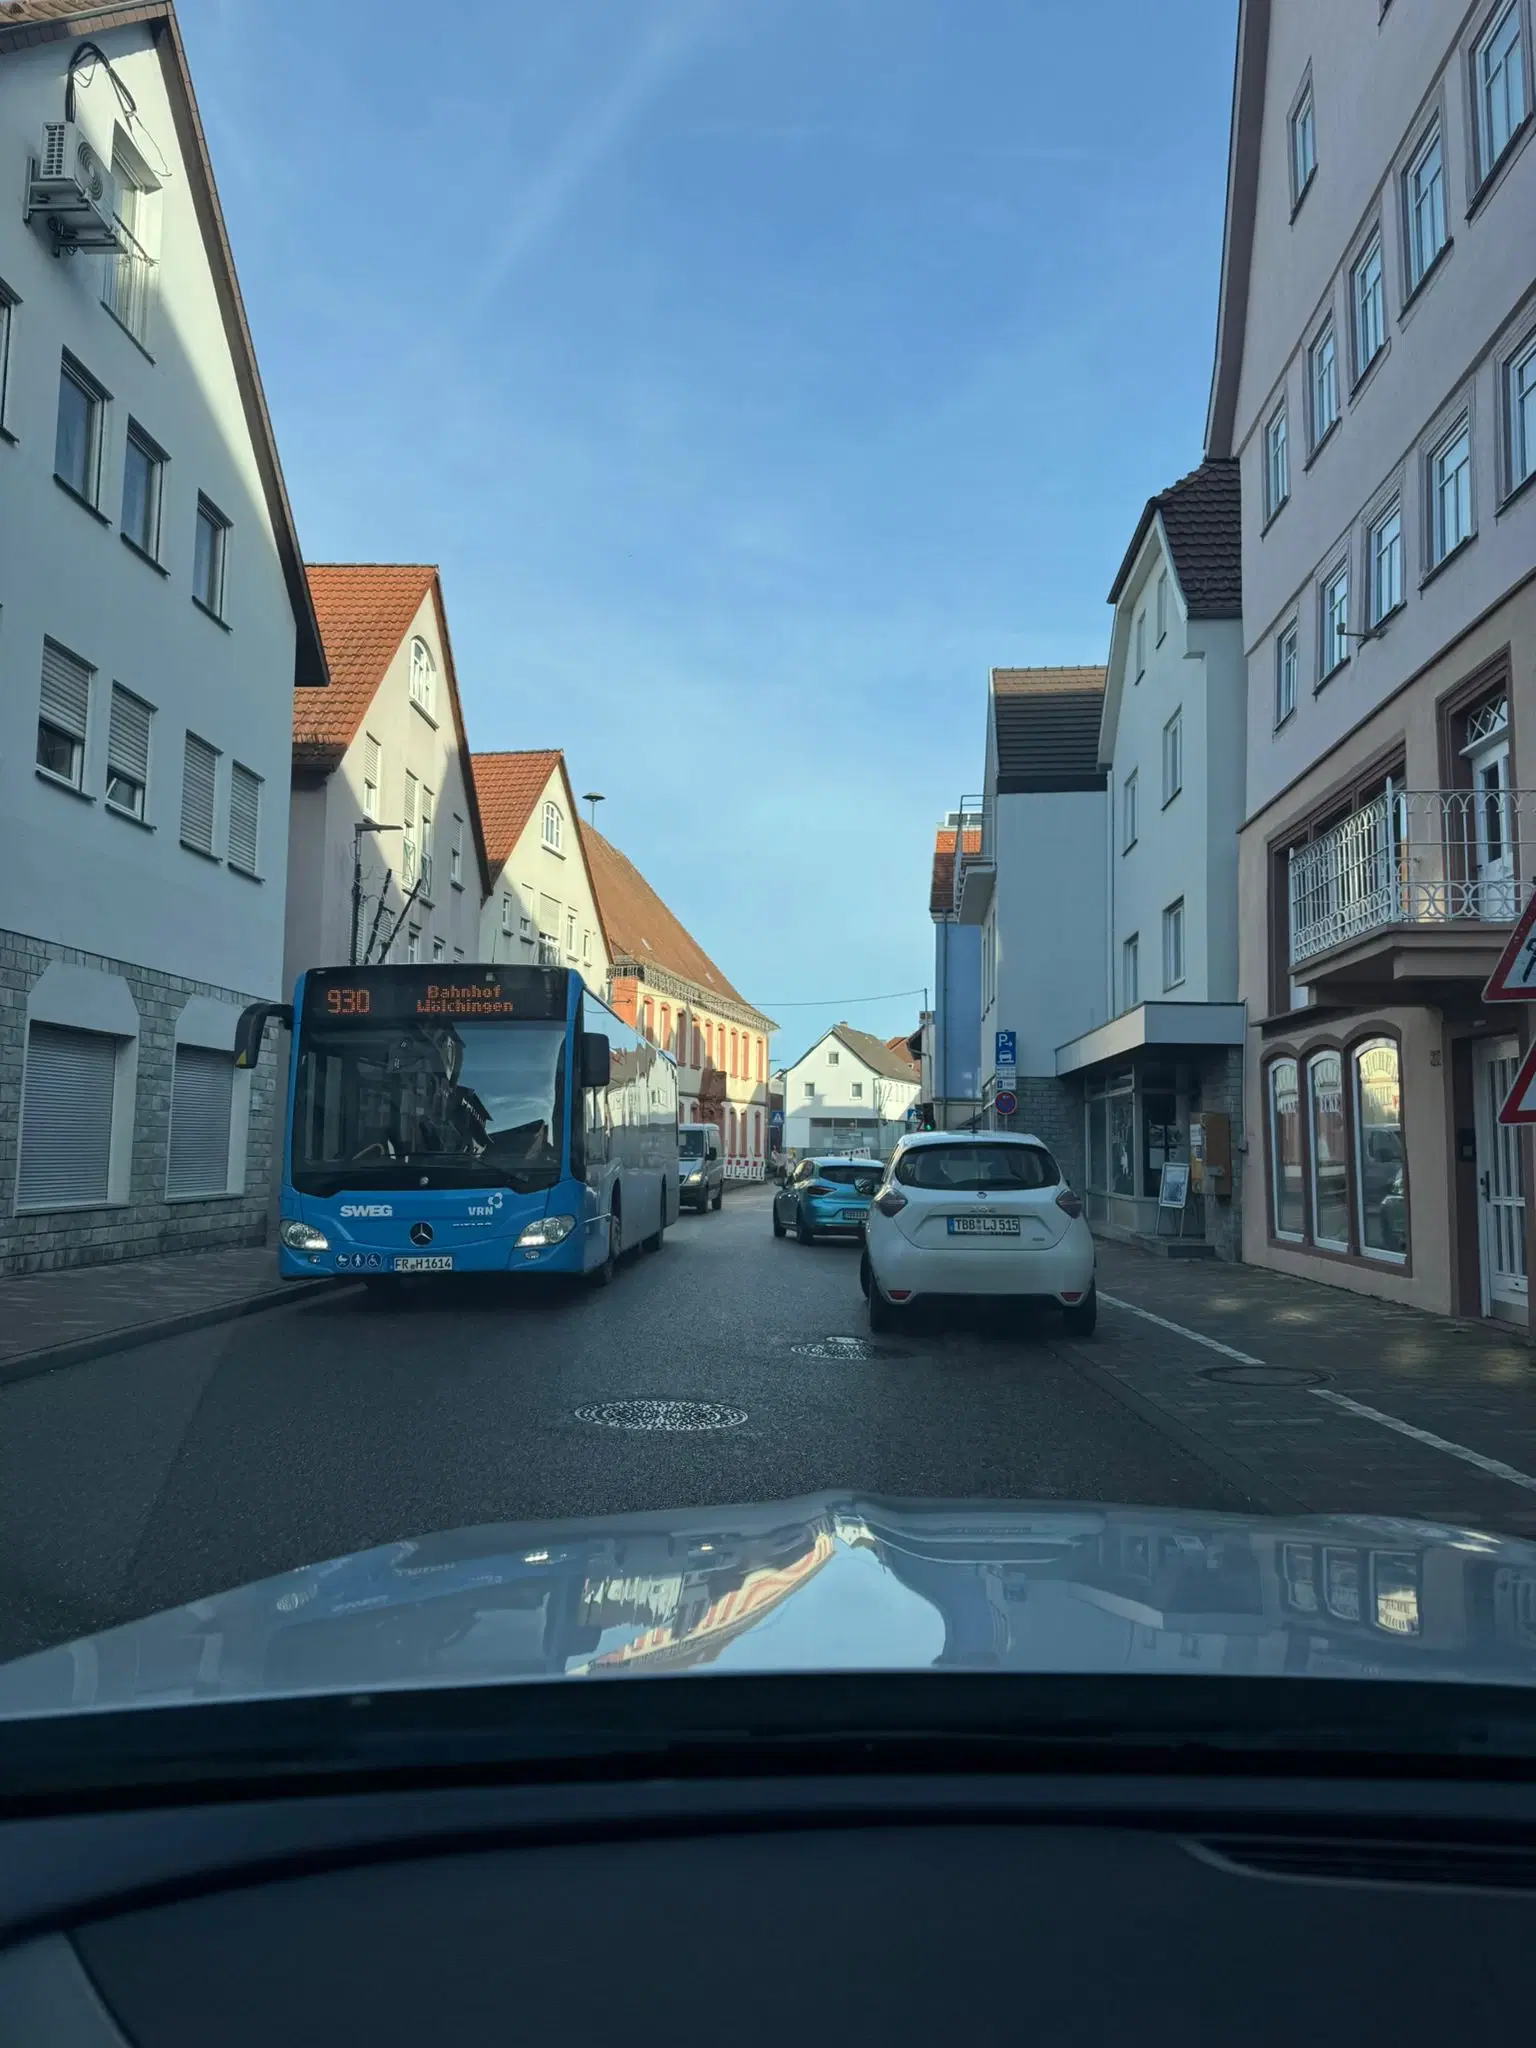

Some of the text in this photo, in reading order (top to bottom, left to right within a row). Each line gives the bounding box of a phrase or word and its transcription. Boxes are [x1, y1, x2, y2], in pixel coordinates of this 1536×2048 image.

[427, 984, 501, 999] Bahnhof
[328, 989, 370, 1013] 930
[998, 1033, 1008, 1047] P
[339, 1205, 393, 1218] SWEG
[467, 1206, 494, 1216] VRN
[955, 1219, 976, 1231] TBB
[395, 1258, 409, 1270] FR
